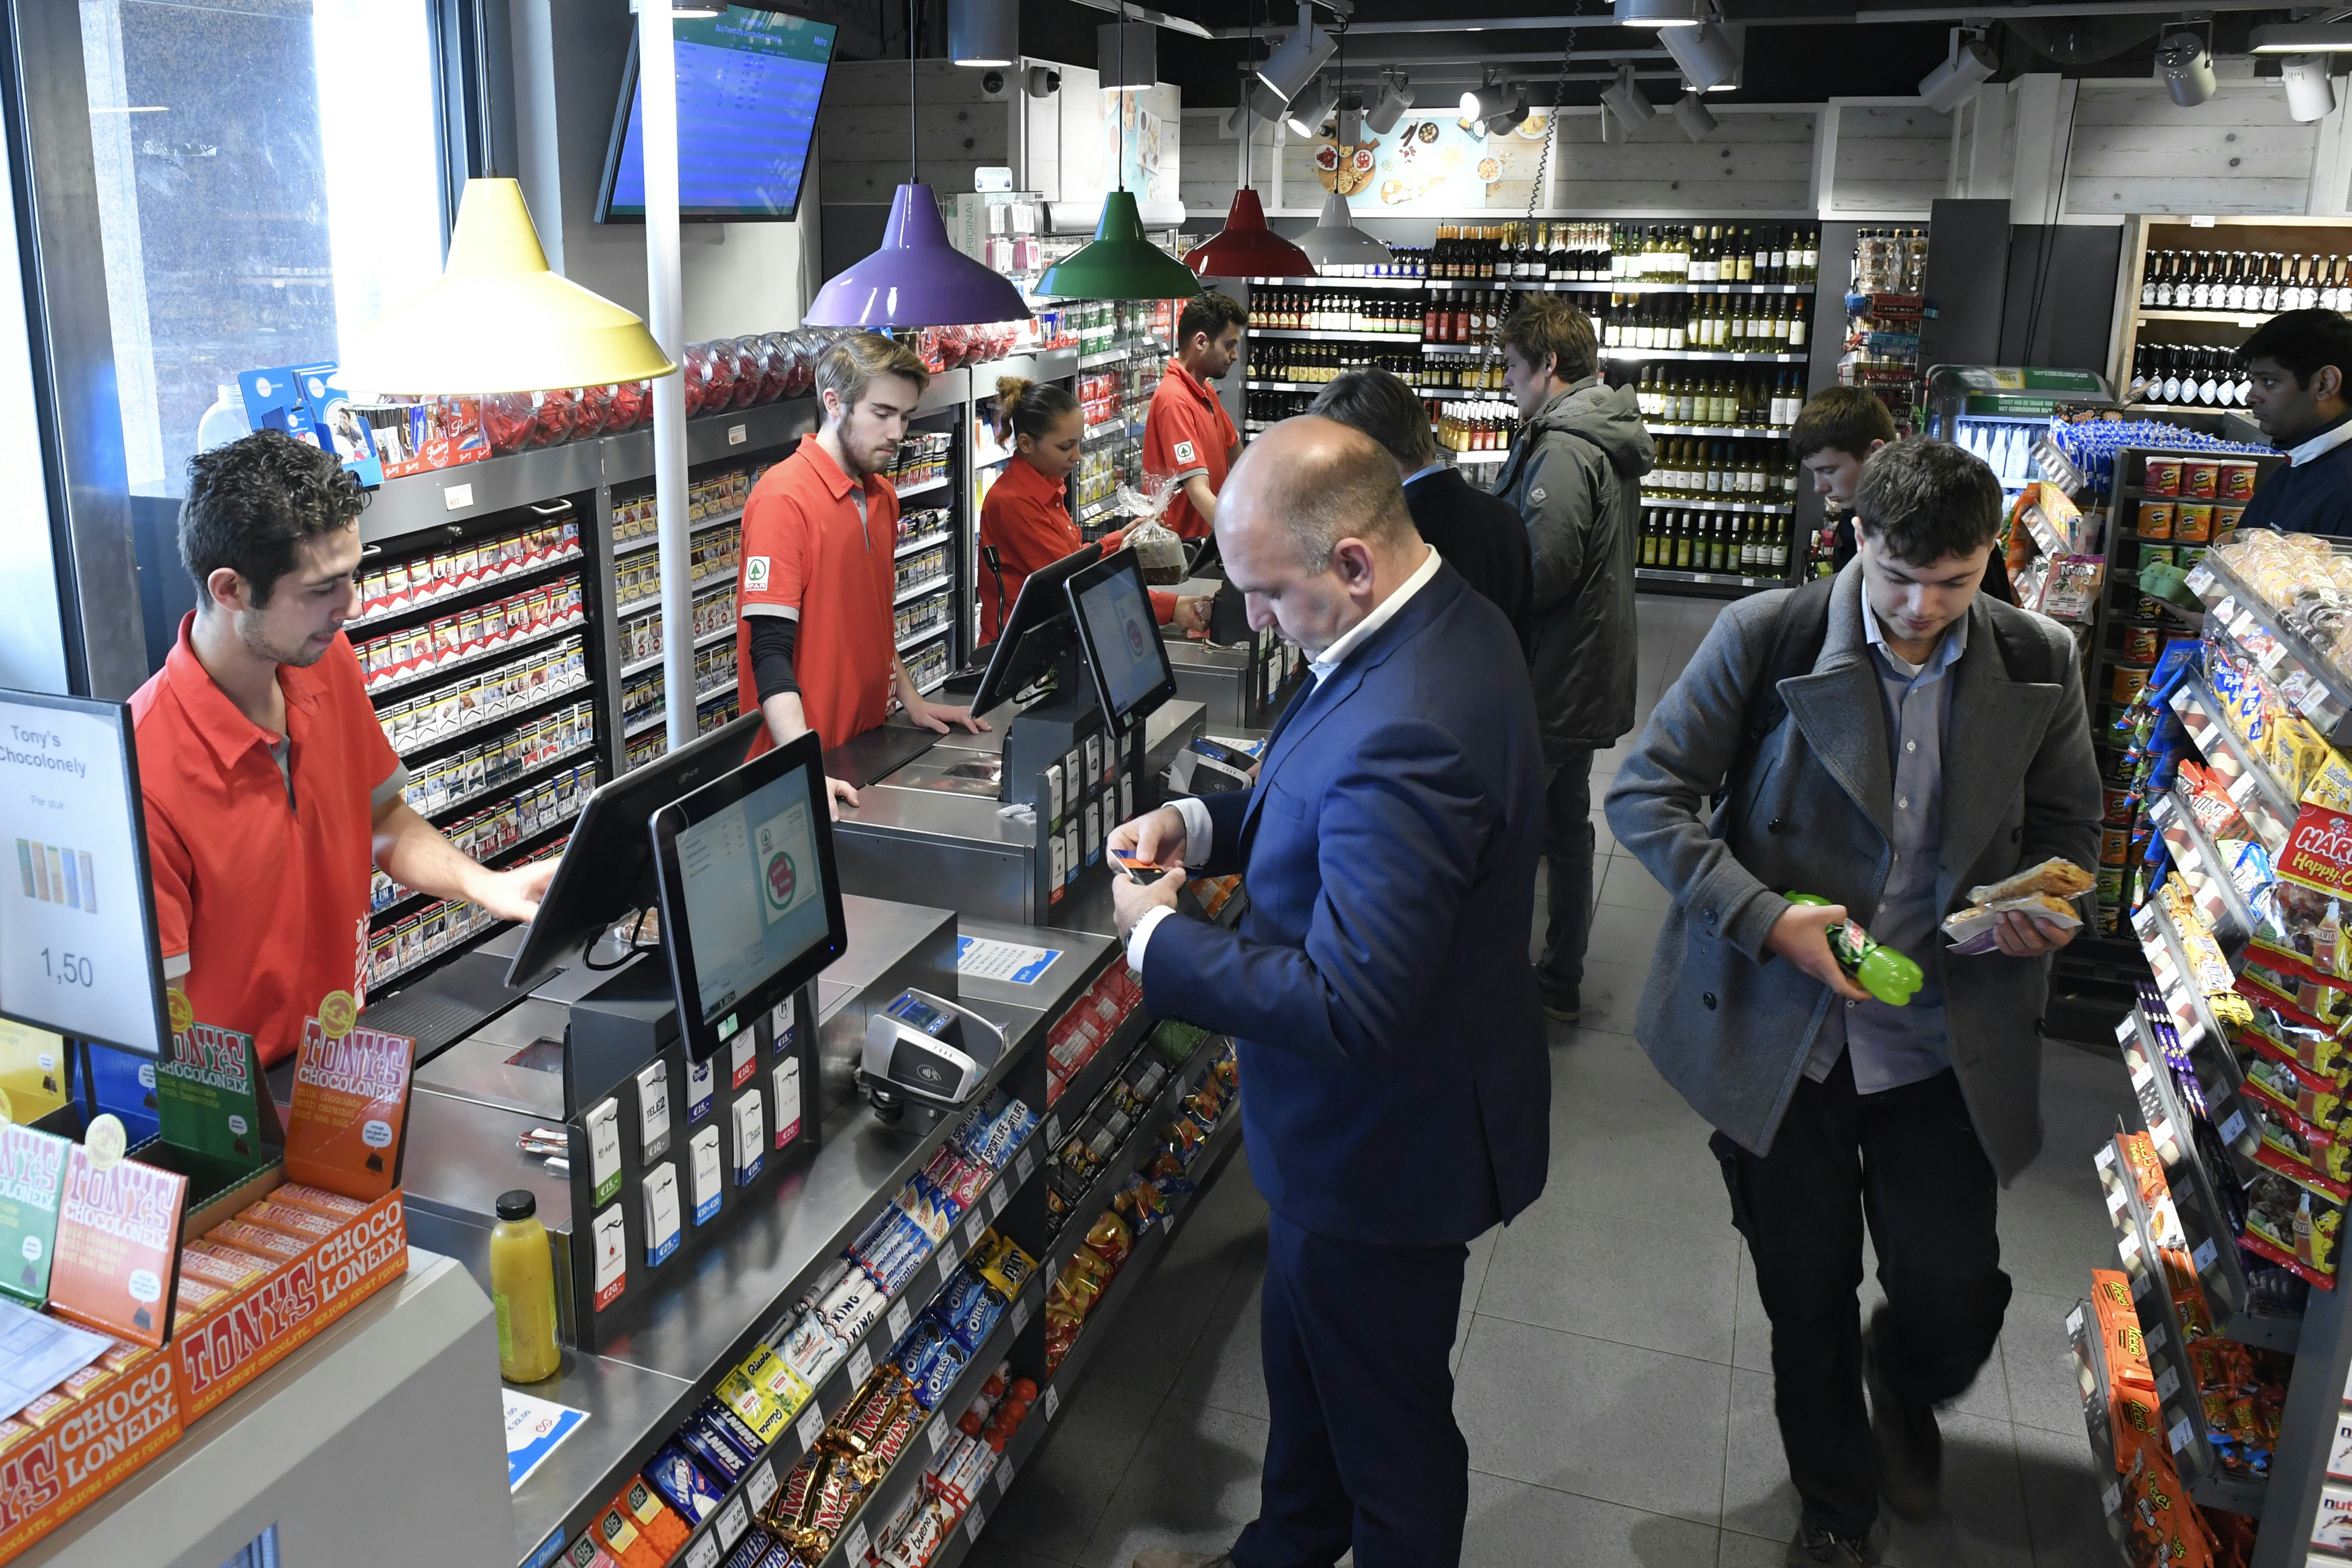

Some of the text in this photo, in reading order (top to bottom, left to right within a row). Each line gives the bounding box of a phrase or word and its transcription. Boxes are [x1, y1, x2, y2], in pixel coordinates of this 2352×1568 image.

[814, 36, 828, 46] Metro
[11, 725, 61, 749] Tony's
[0, 746, 86, 779] Chocolonely
[2295, 826, 2352, 865] HAR
[40, 947, 93, 988] 1,50
[172, 1025, 247, 1079] ONY'S
[302, 1019, 409, 1087] TONY'S
[738, 1064, 752, 1079] €10,-
[296, 1099, 355, 1119] with caramel
[297, 1087, 362, 1109] milk chocolate
[647, 1096, 665, 1115] TELE2
[693, 1102, 709, 1116] €15,-
[294, 1109, 311, 1120] and
[605, 1141, 615, 1153] kpn
[783, 1125, 797, 1139] €20,-
[984, 1122, 1006, 1160] SPORTLIFE
[649, 1141, 665, 1157] €10,-
[748, 1161, 760, 1176] €10,-
[68, 1145, 180, 1233] TONY'S
[601, 1179, 618, 1196] €15,-
[316, 1200, 401, 1272] CHOCO
[659, 1239, 677, 1256] €25,-
[320, 1226, 403, 1304] LONELY
[876, 1239, 902, 1271] mentos
[886, 1249, 912, 1281] mentos
[603, 1282, 621, 1300] €20,-
[892, 1258, 920, 1293] mentos
[949, 1275, 970, 1310] OREO
[2109, 1279, 2130, 1308] Reese's
[181, 1256, 318, 1395] TONY'S
[831, 1295, 860, 1325] KING
[850, 1310, 874, 1342] KING
[967, 1298, 988, 1333] OREO
[191, 1386, 223, 1413] CRAZY
[225, 1363, 256, 1390] ABOUT
[314, 1298, 348, 1328] SERIOUS
[349, 1277, 376, 1302] ABOUT
[378, 1256, 406, 1282] PEOPLE
[2127, 1324, 2143, 1357] Reese's
[747, 1350, 772, 1377] Ricola
[903, 1334, 928, 1375] OREO
[929, 1356, 950, 1395] OREO
[58, 1361, 172, 1453] CHOCO
[758, 1408, 783, 1435] Ricola
[811, 1415, 822, 1428] 1,14
[848, 1391, 891, 1440] TWIX
[2130, 1398, 2151, 1433] Reese's
[64, 1391, 173, 1489] LONELY
[719, 1407, 763, 1449] SMINT
[873, 1417, 911, 1467] TWIX
[700, 1426, 746, 1470] SMINT
[56, 1423, 180, 1517] SERIOUS ABOUT PEOPLE
[762, 1473, 773, 1484] 1,75
[631, 1486, 642, 1498] tic
[634, 1492, 647, 1506] tac
[776, 1466, 812, 1520] TWIX
[813, 1473, 842, 1530] TWIX
[603, 1513, 617, 1526] tic
[608, 1519, 622, 1536] tac
[732, 1506, 743, 1521] 2,00
[910, 1516, 931, 1550] bueno
[702, 1544, 714, 1559] 3,14
